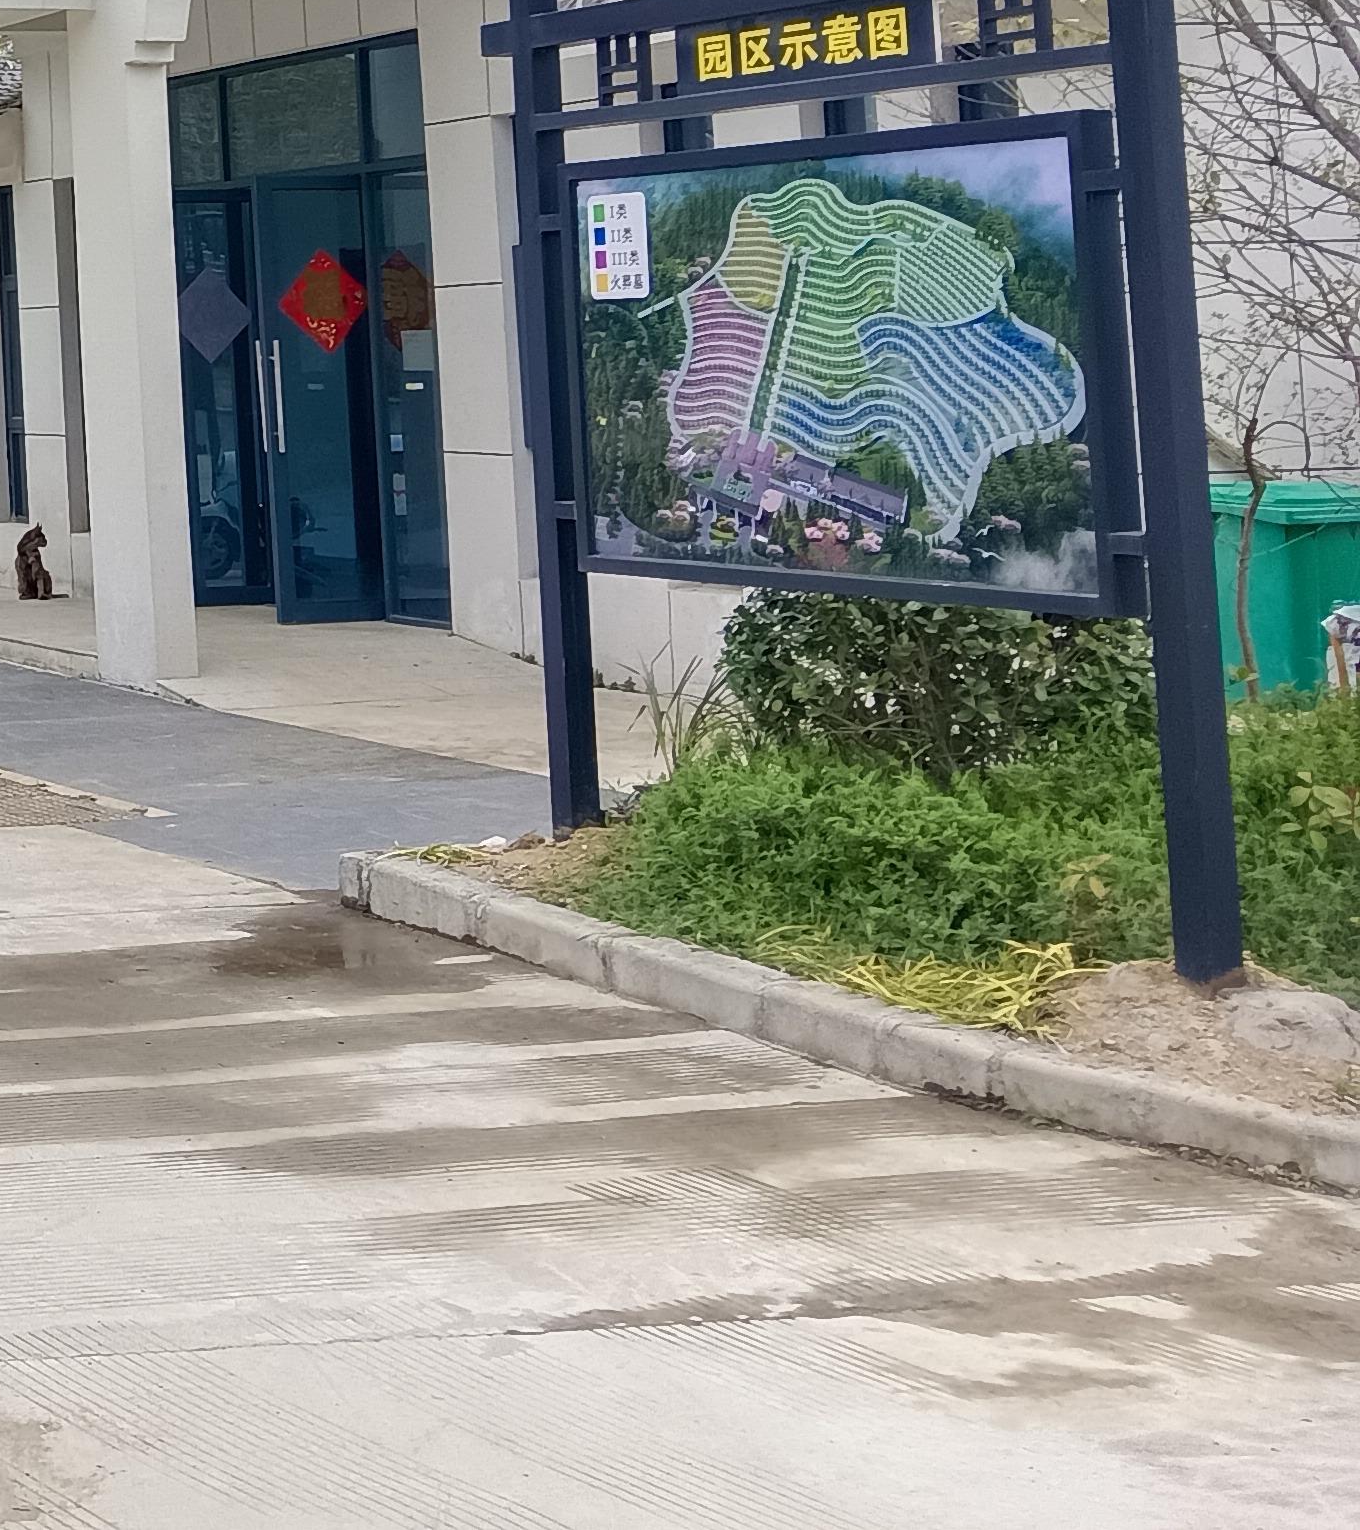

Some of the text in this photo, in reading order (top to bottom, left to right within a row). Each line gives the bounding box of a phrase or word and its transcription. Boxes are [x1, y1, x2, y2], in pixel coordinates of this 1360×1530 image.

[697, 7, 909, 81] 园区示意图
